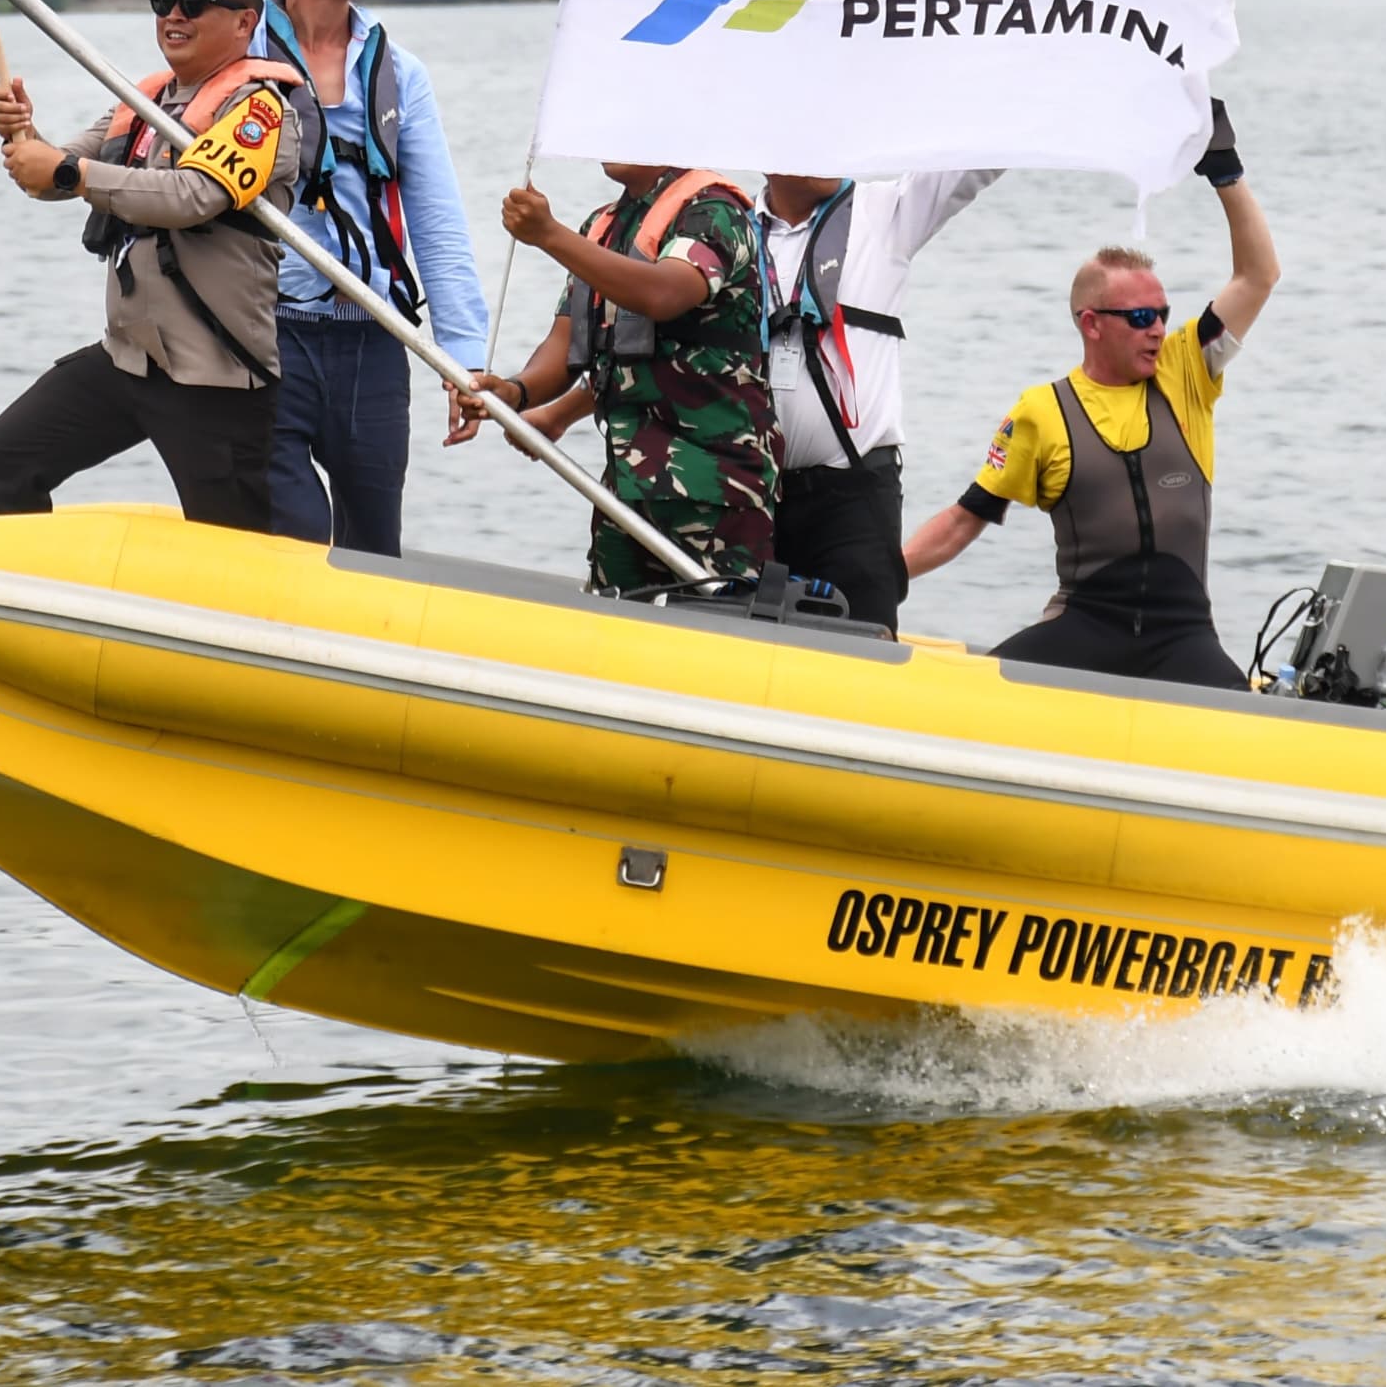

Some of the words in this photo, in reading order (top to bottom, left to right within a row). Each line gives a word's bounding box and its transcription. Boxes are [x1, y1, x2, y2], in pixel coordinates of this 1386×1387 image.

[192, 138, 257, 191] PJKO
[827, 889, 1009, 971] OSPREY
[1008, 912, 1296, 1001] POWERBOAT
